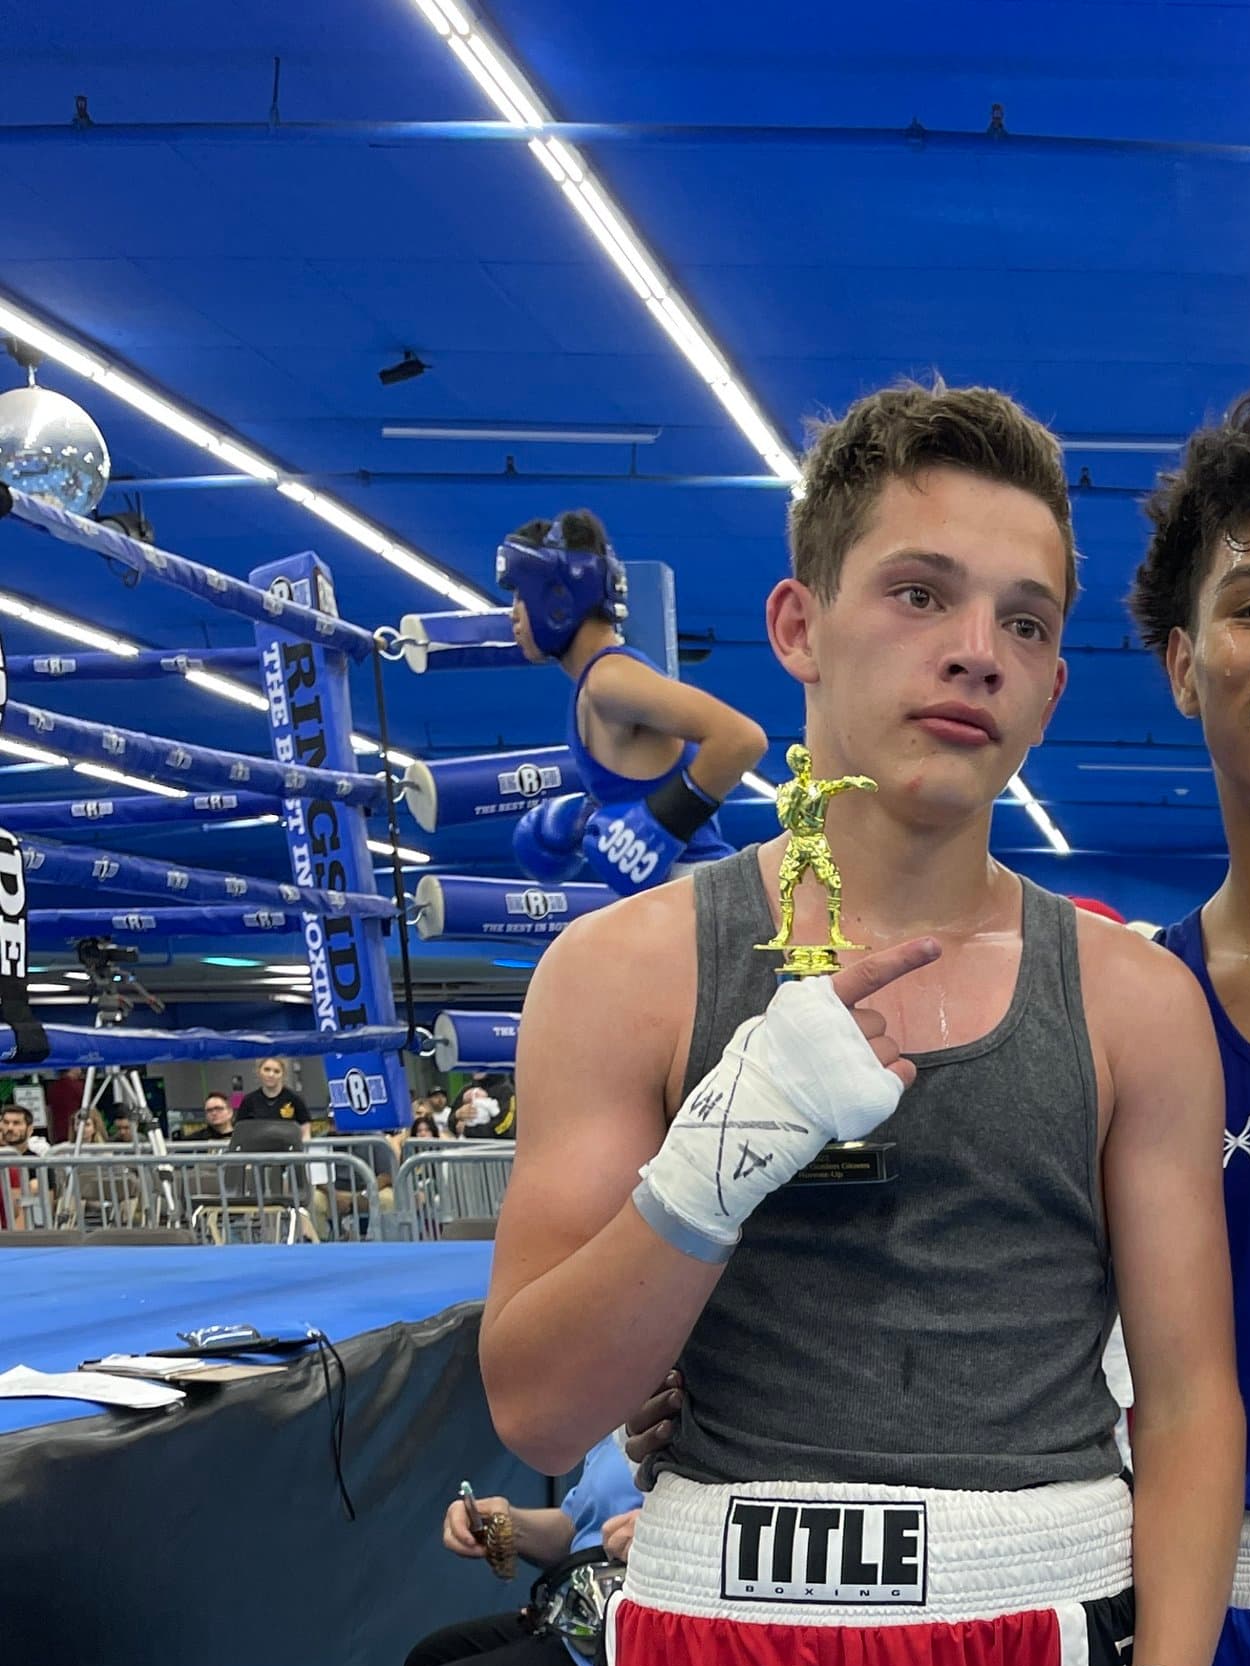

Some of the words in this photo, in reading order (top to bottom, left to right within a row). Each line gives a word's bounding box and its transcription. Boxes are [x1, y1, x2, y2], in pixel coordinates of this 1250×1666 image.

[263, 641, 289, 728] THE
[275, 734, 306, 835] BST
[731, 1503, 920, 1586] TITLE
[745, 1584, 902, 1598] BOXING
